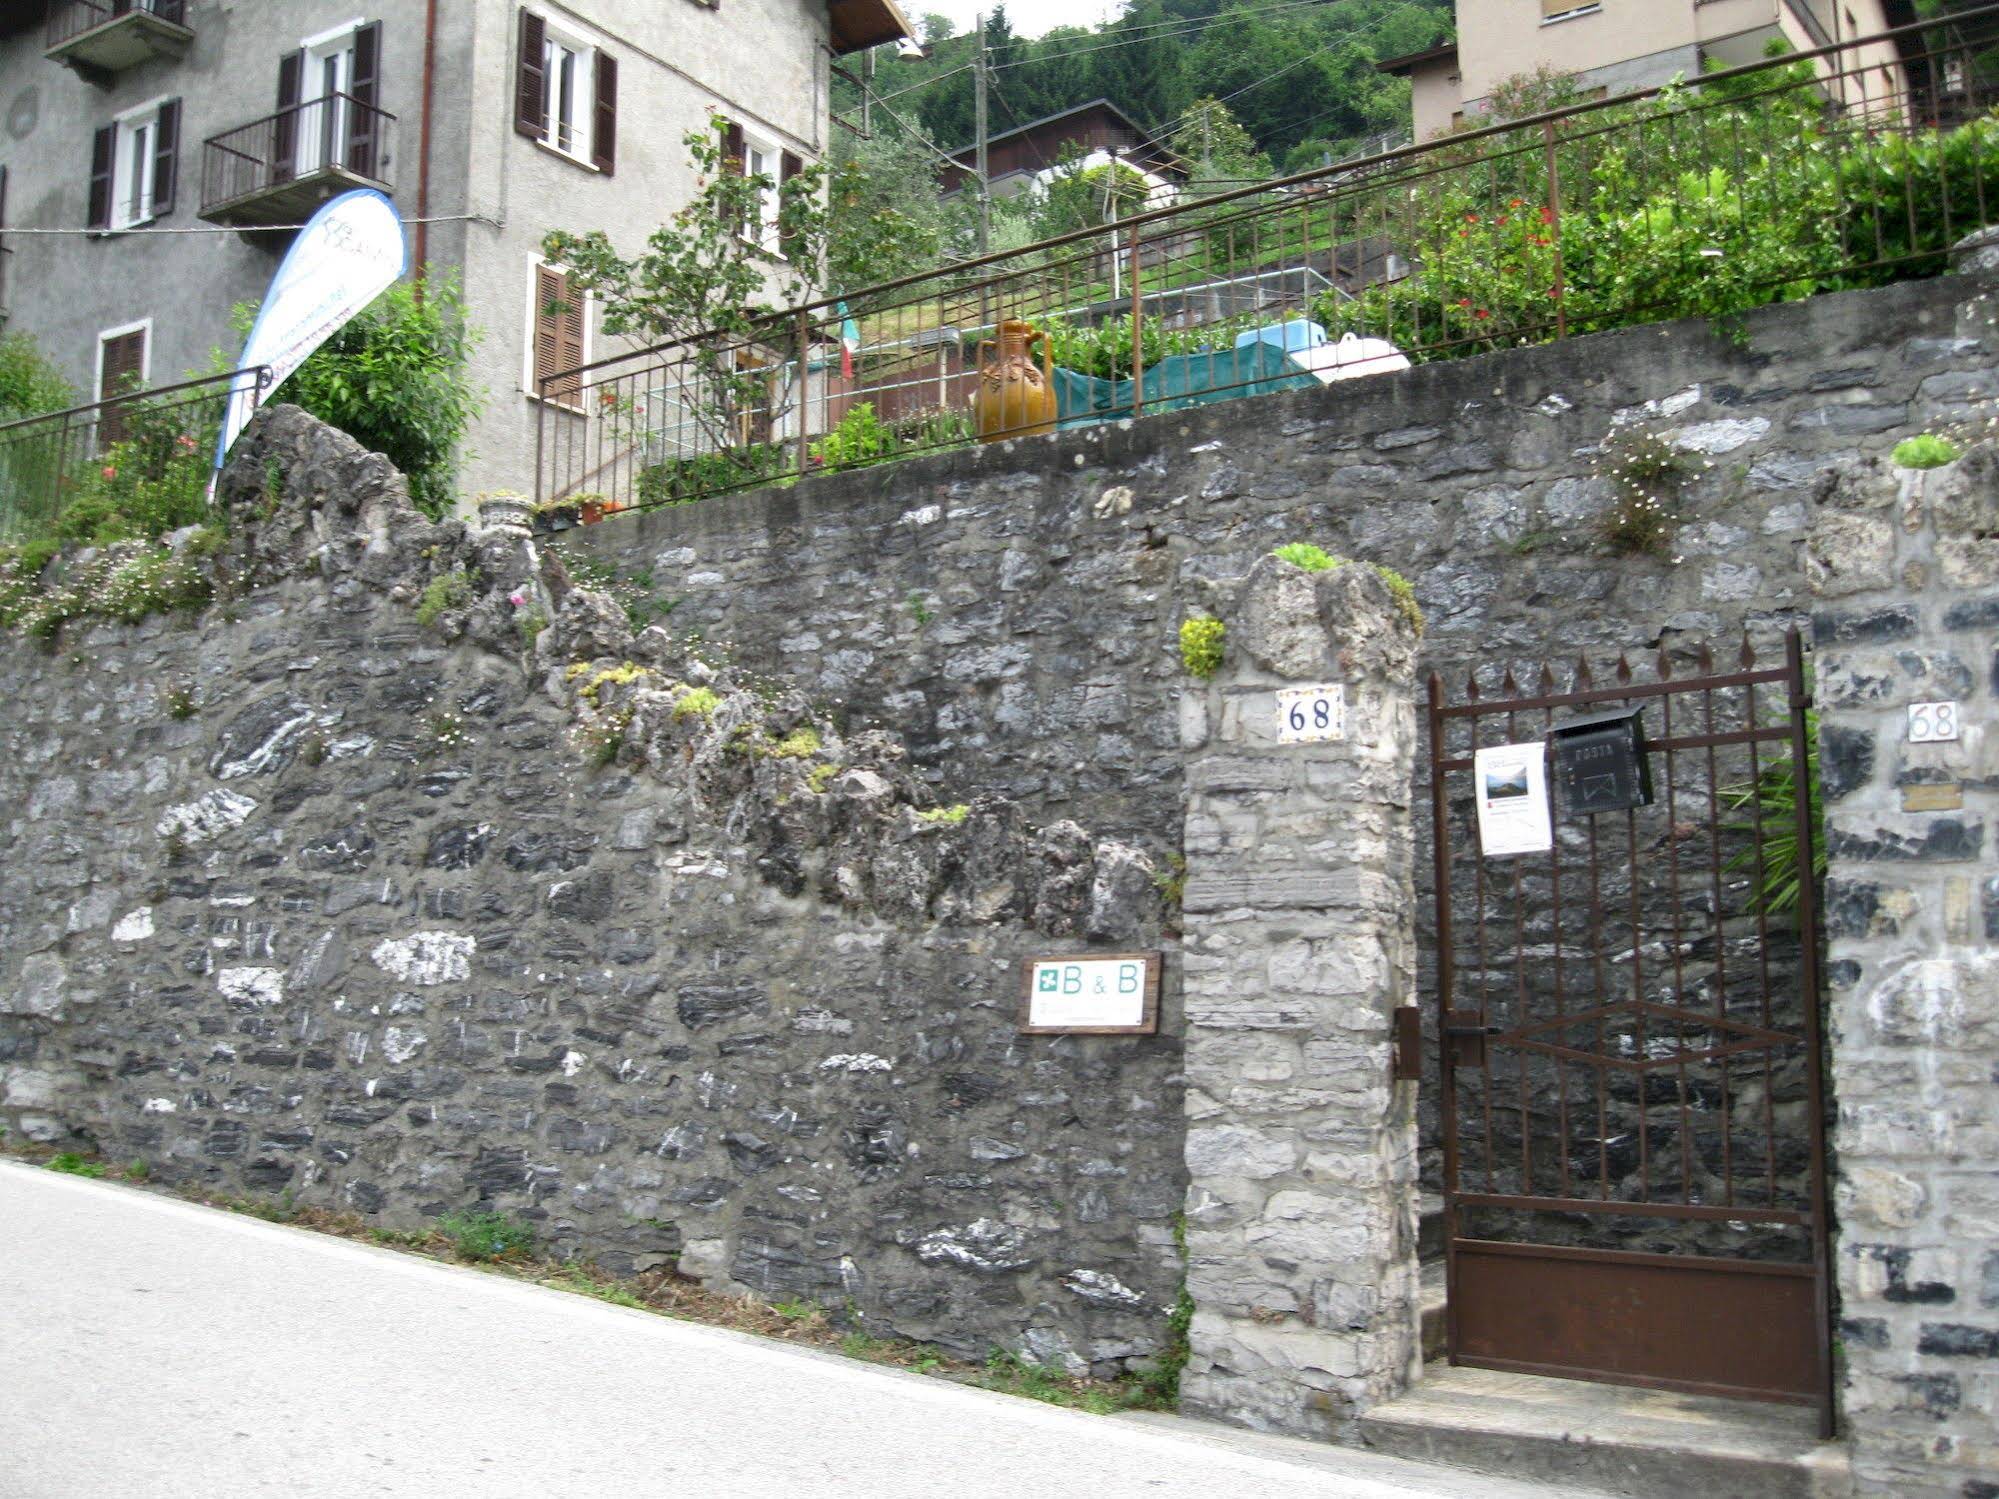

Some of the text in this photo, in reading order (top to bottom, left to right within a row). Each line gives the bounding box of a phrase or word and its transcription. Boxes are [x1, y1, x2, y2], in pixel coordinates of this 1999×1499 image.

[1289, 699, 1329, 731] 68
[1910, 704, 1953, 737] 68
[1063, 965, 1082, 994] B
[1119, 964, 1138, 993] B
